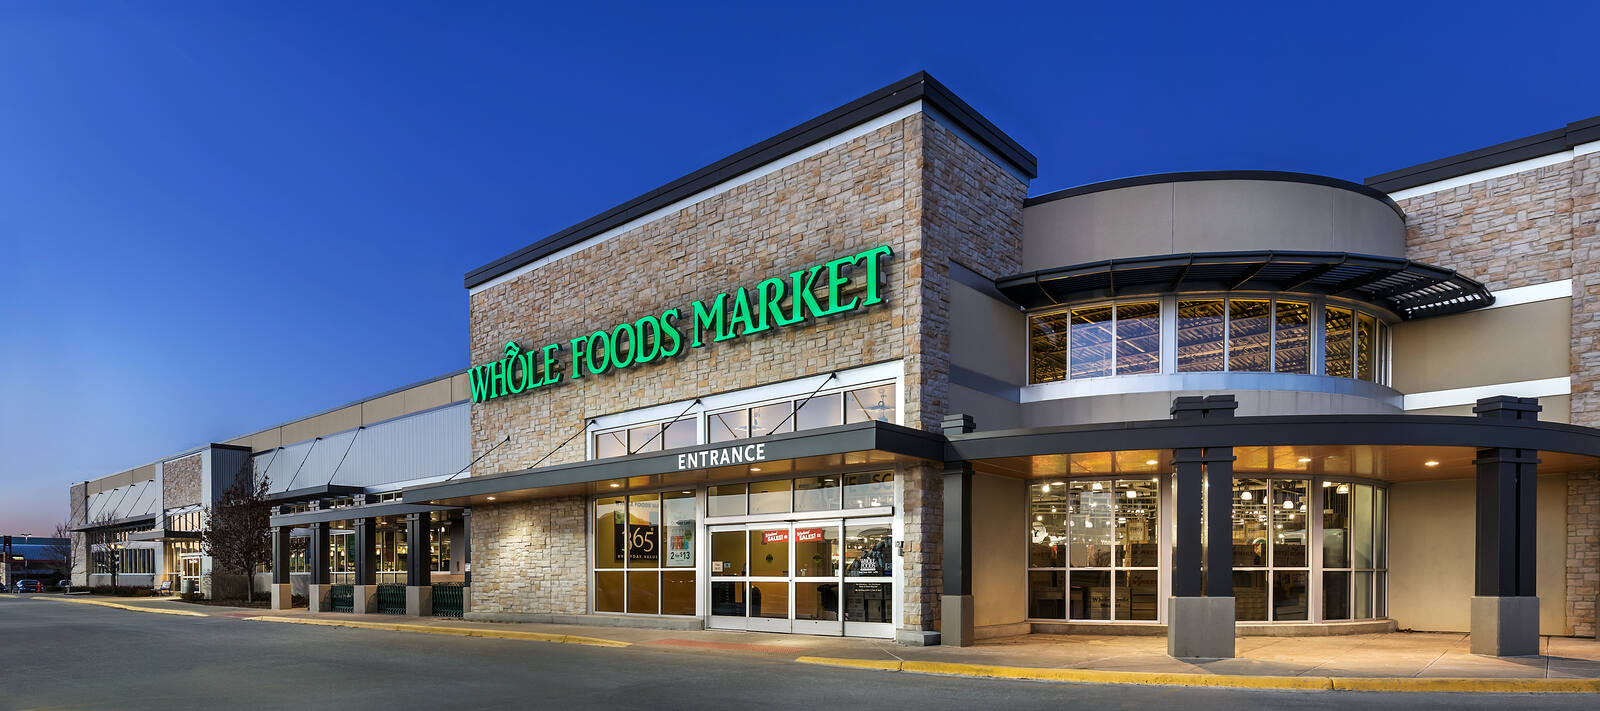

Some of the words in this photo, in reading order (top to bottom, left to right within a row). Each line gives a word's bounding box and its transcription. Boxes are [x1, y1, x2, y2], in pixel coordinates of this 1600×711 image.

[467, 341, 561, 403] WHOLE
[570, 307, 682, 379] FOODS
[691, 245, 892, 348] MARKET
[678, 443, 766, 470] ENTRANCE
[670, 552, 675, 560] 2
